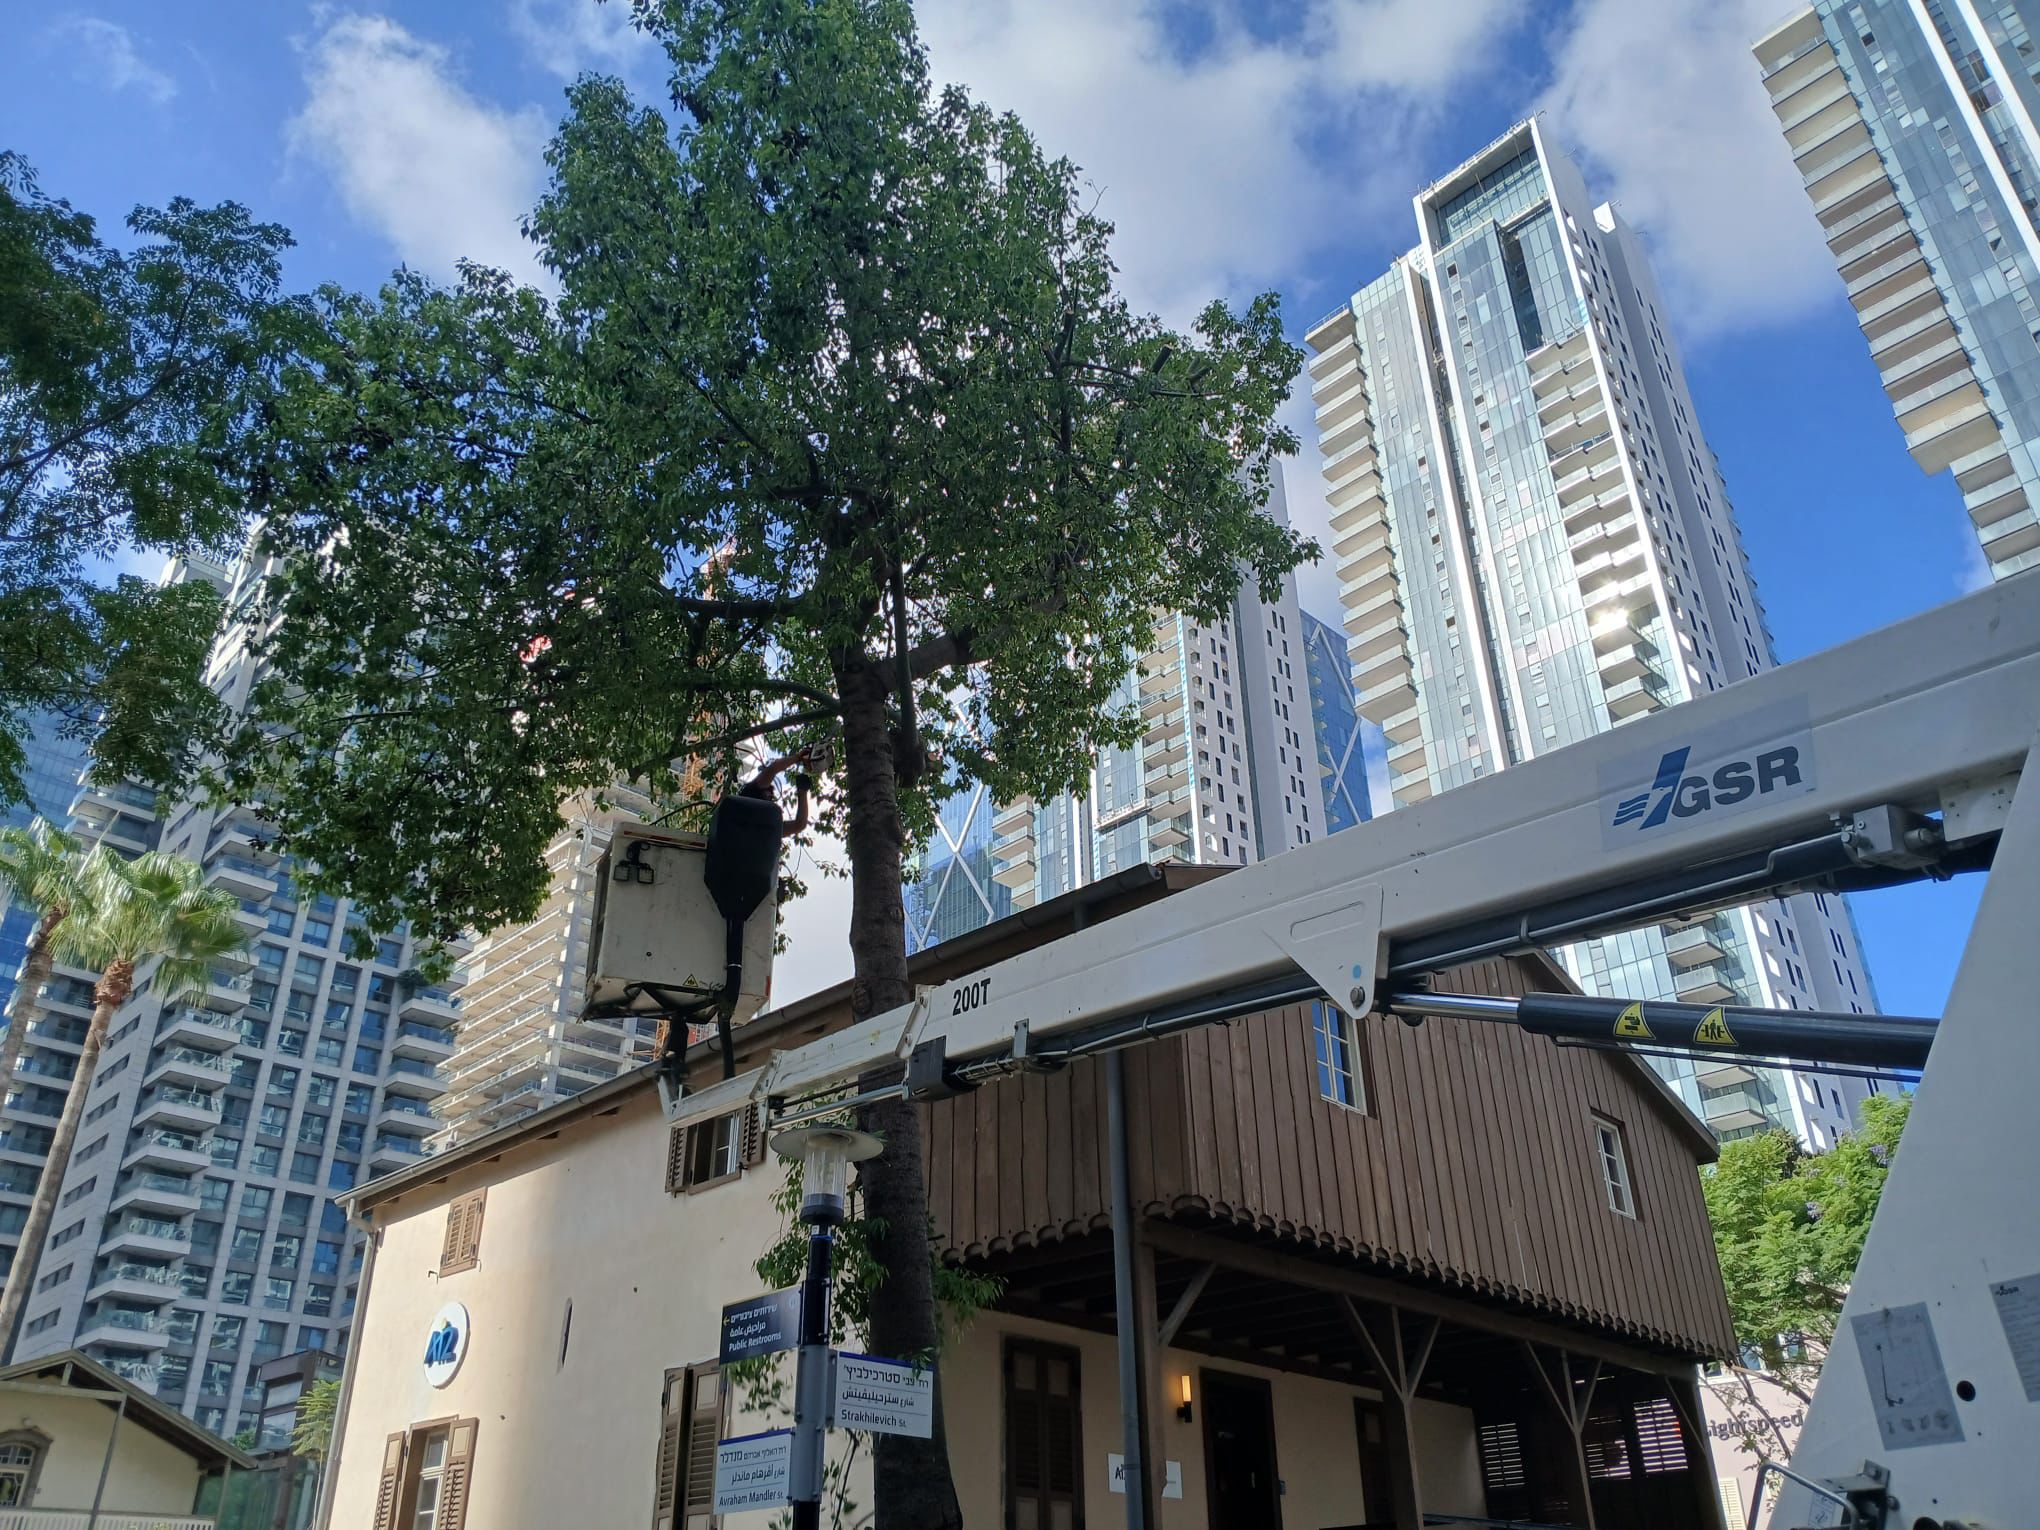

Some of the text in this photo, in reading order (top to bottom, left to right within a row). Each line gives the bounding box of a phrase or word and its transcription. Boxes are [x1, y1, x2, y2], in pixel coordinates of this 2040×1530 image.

[1671, 745, 1802, 818] GSR
[952, 977, 991, 1016] 200T
[728, 1331, 782, 1352] Public Restrooms
[902, 1376, 915, 1386] צבי
[900, 1397, 915, 1408] شارع
[841, 1409, 897, 1427] Strakhilevich
[720, 1450, 743, 1465] מנדלר
[719, 1494, 748, 1507] Avraham
[748, 1489, 777, 1503] Mandler
